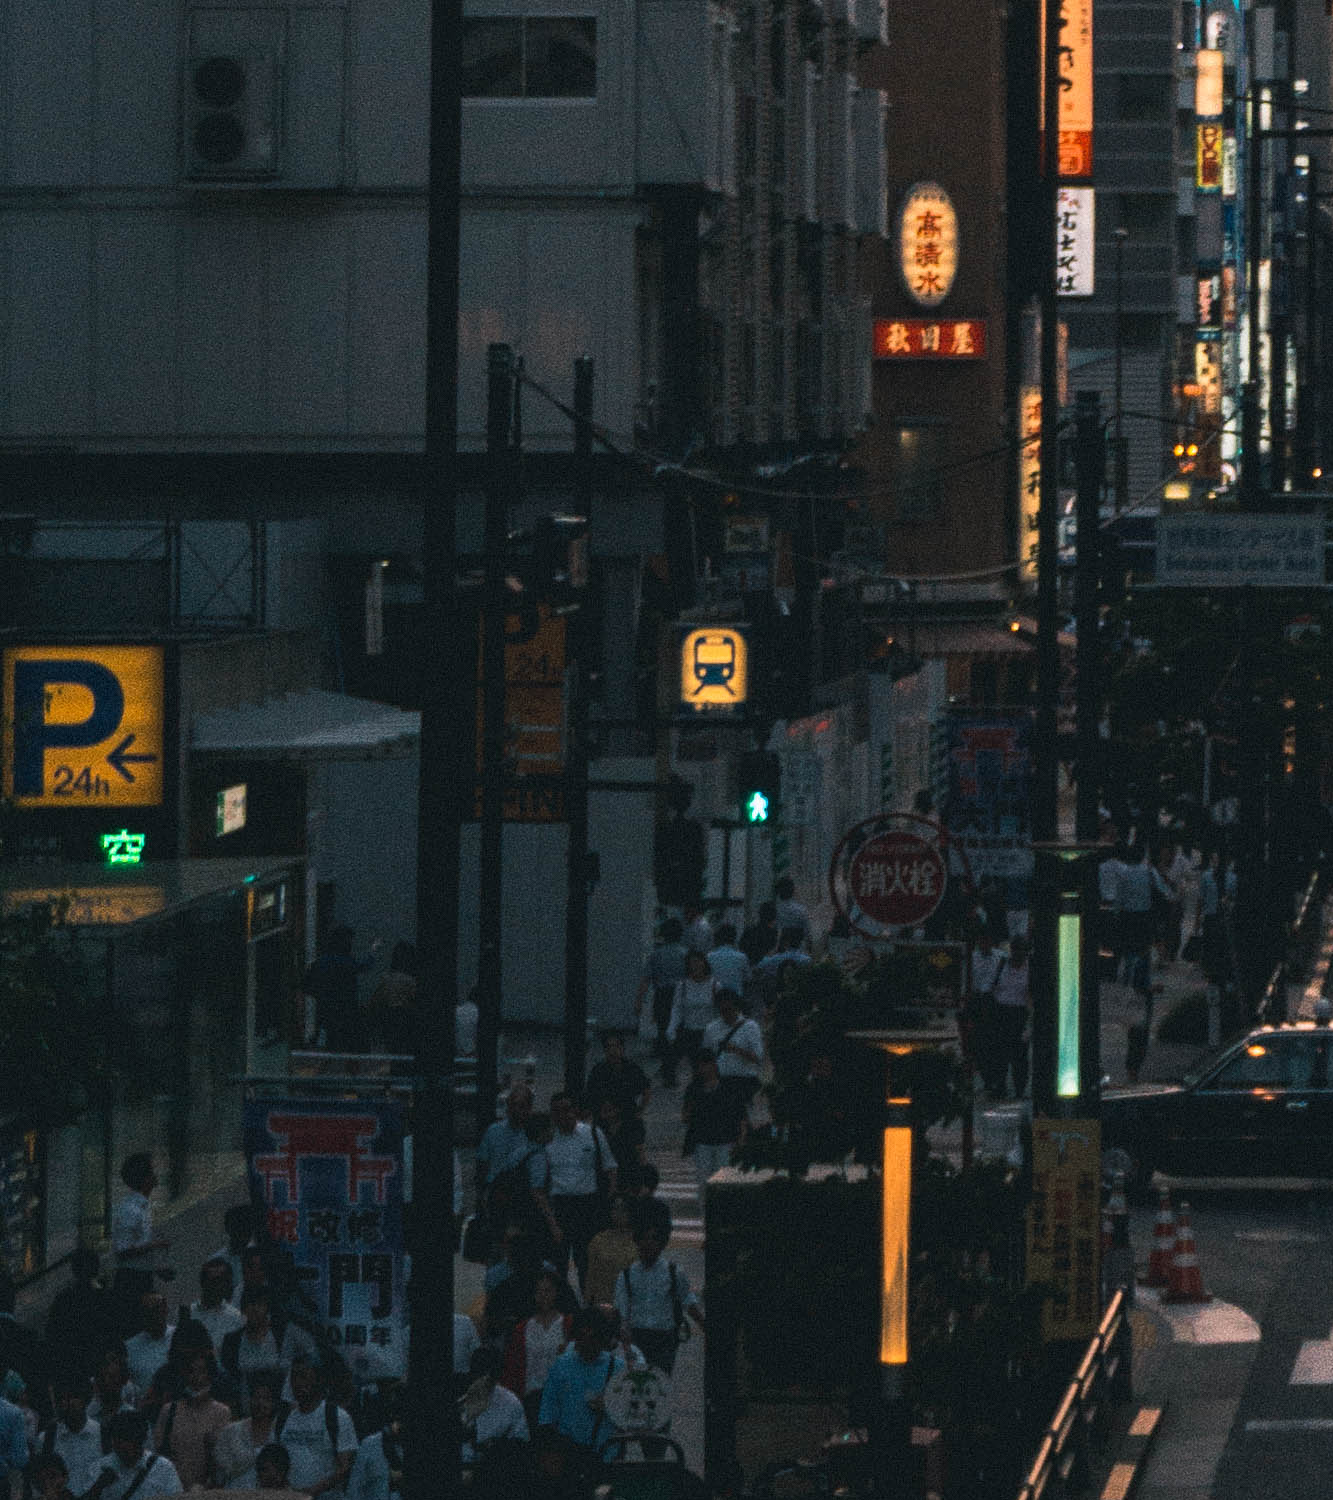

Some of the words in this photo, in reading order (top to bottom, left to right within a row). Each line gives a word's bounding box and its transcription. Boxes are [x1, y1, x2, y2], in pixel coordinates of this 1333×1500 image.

[886, 320, 976, 355] 秋田屋
[14, 660, 124, 798] P
[53, 765, 111, 798] 24h
[857, 859, 938, 897] 消火栓
